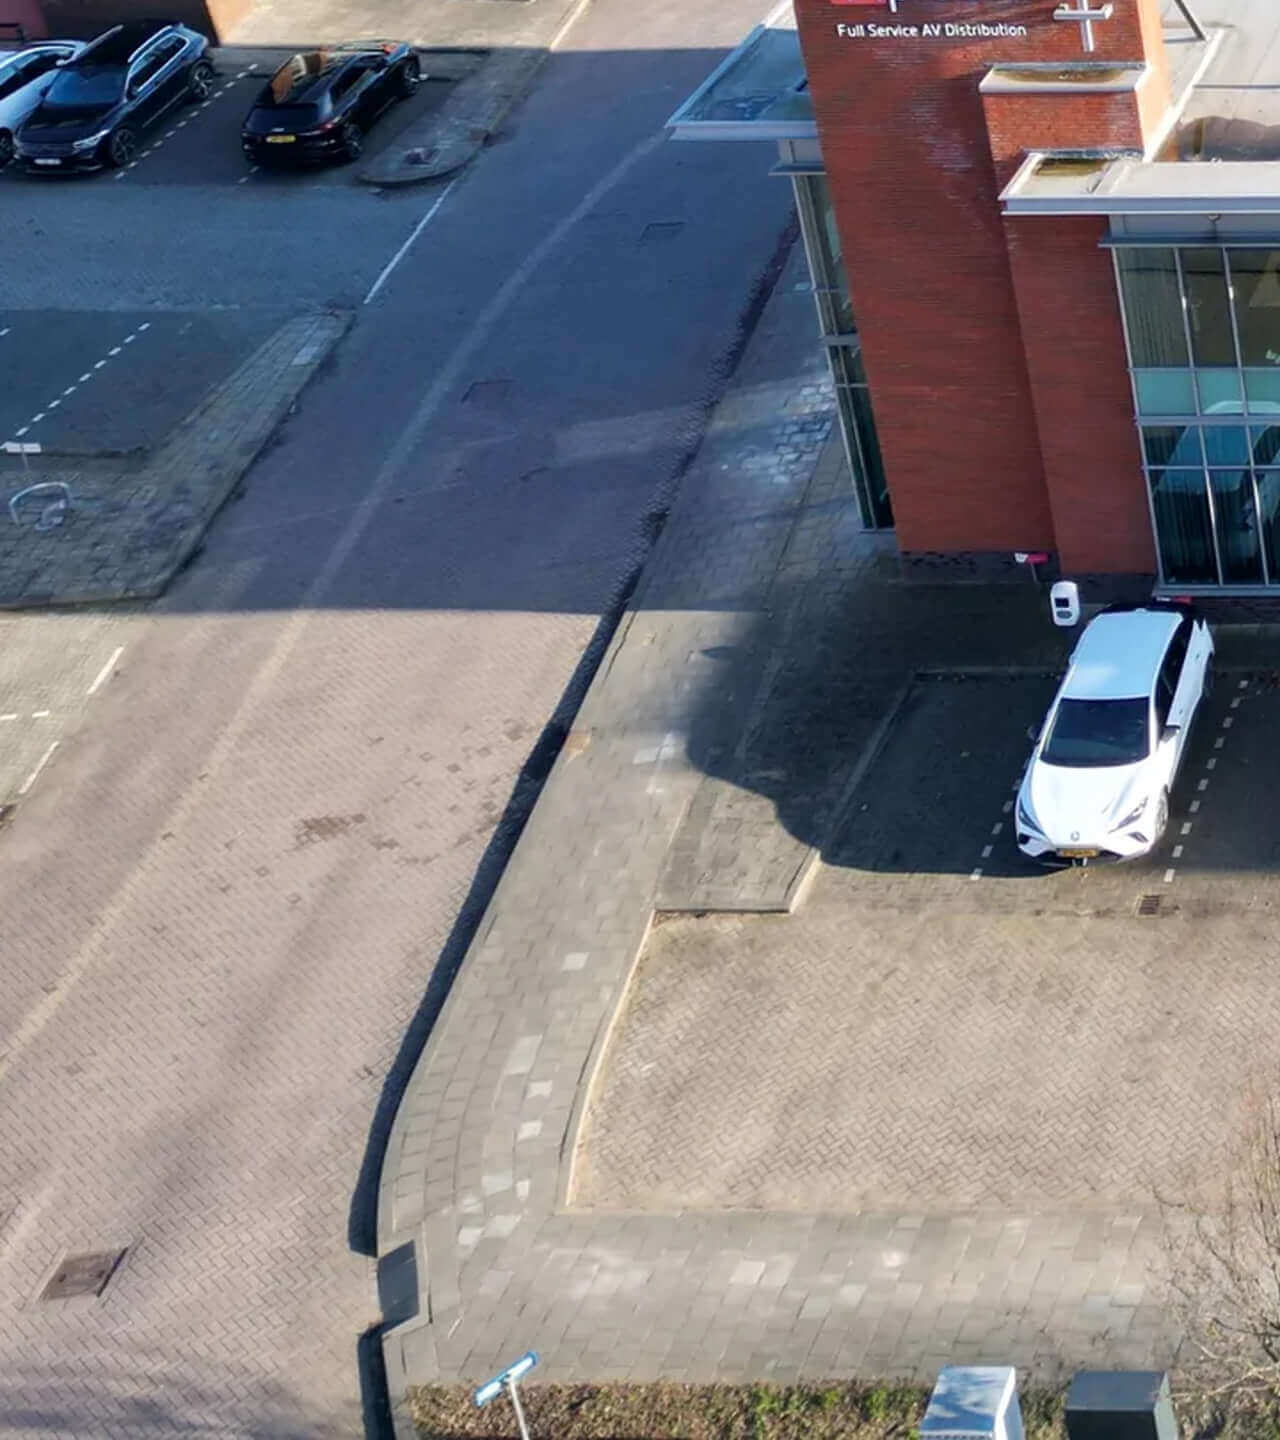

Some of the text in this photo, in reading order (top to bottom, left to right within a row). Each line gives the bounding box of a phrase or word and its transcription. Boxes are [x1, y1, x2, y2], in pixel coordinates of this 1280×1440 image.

[837, 23, 1027, 37] Full Service AV Distribution
